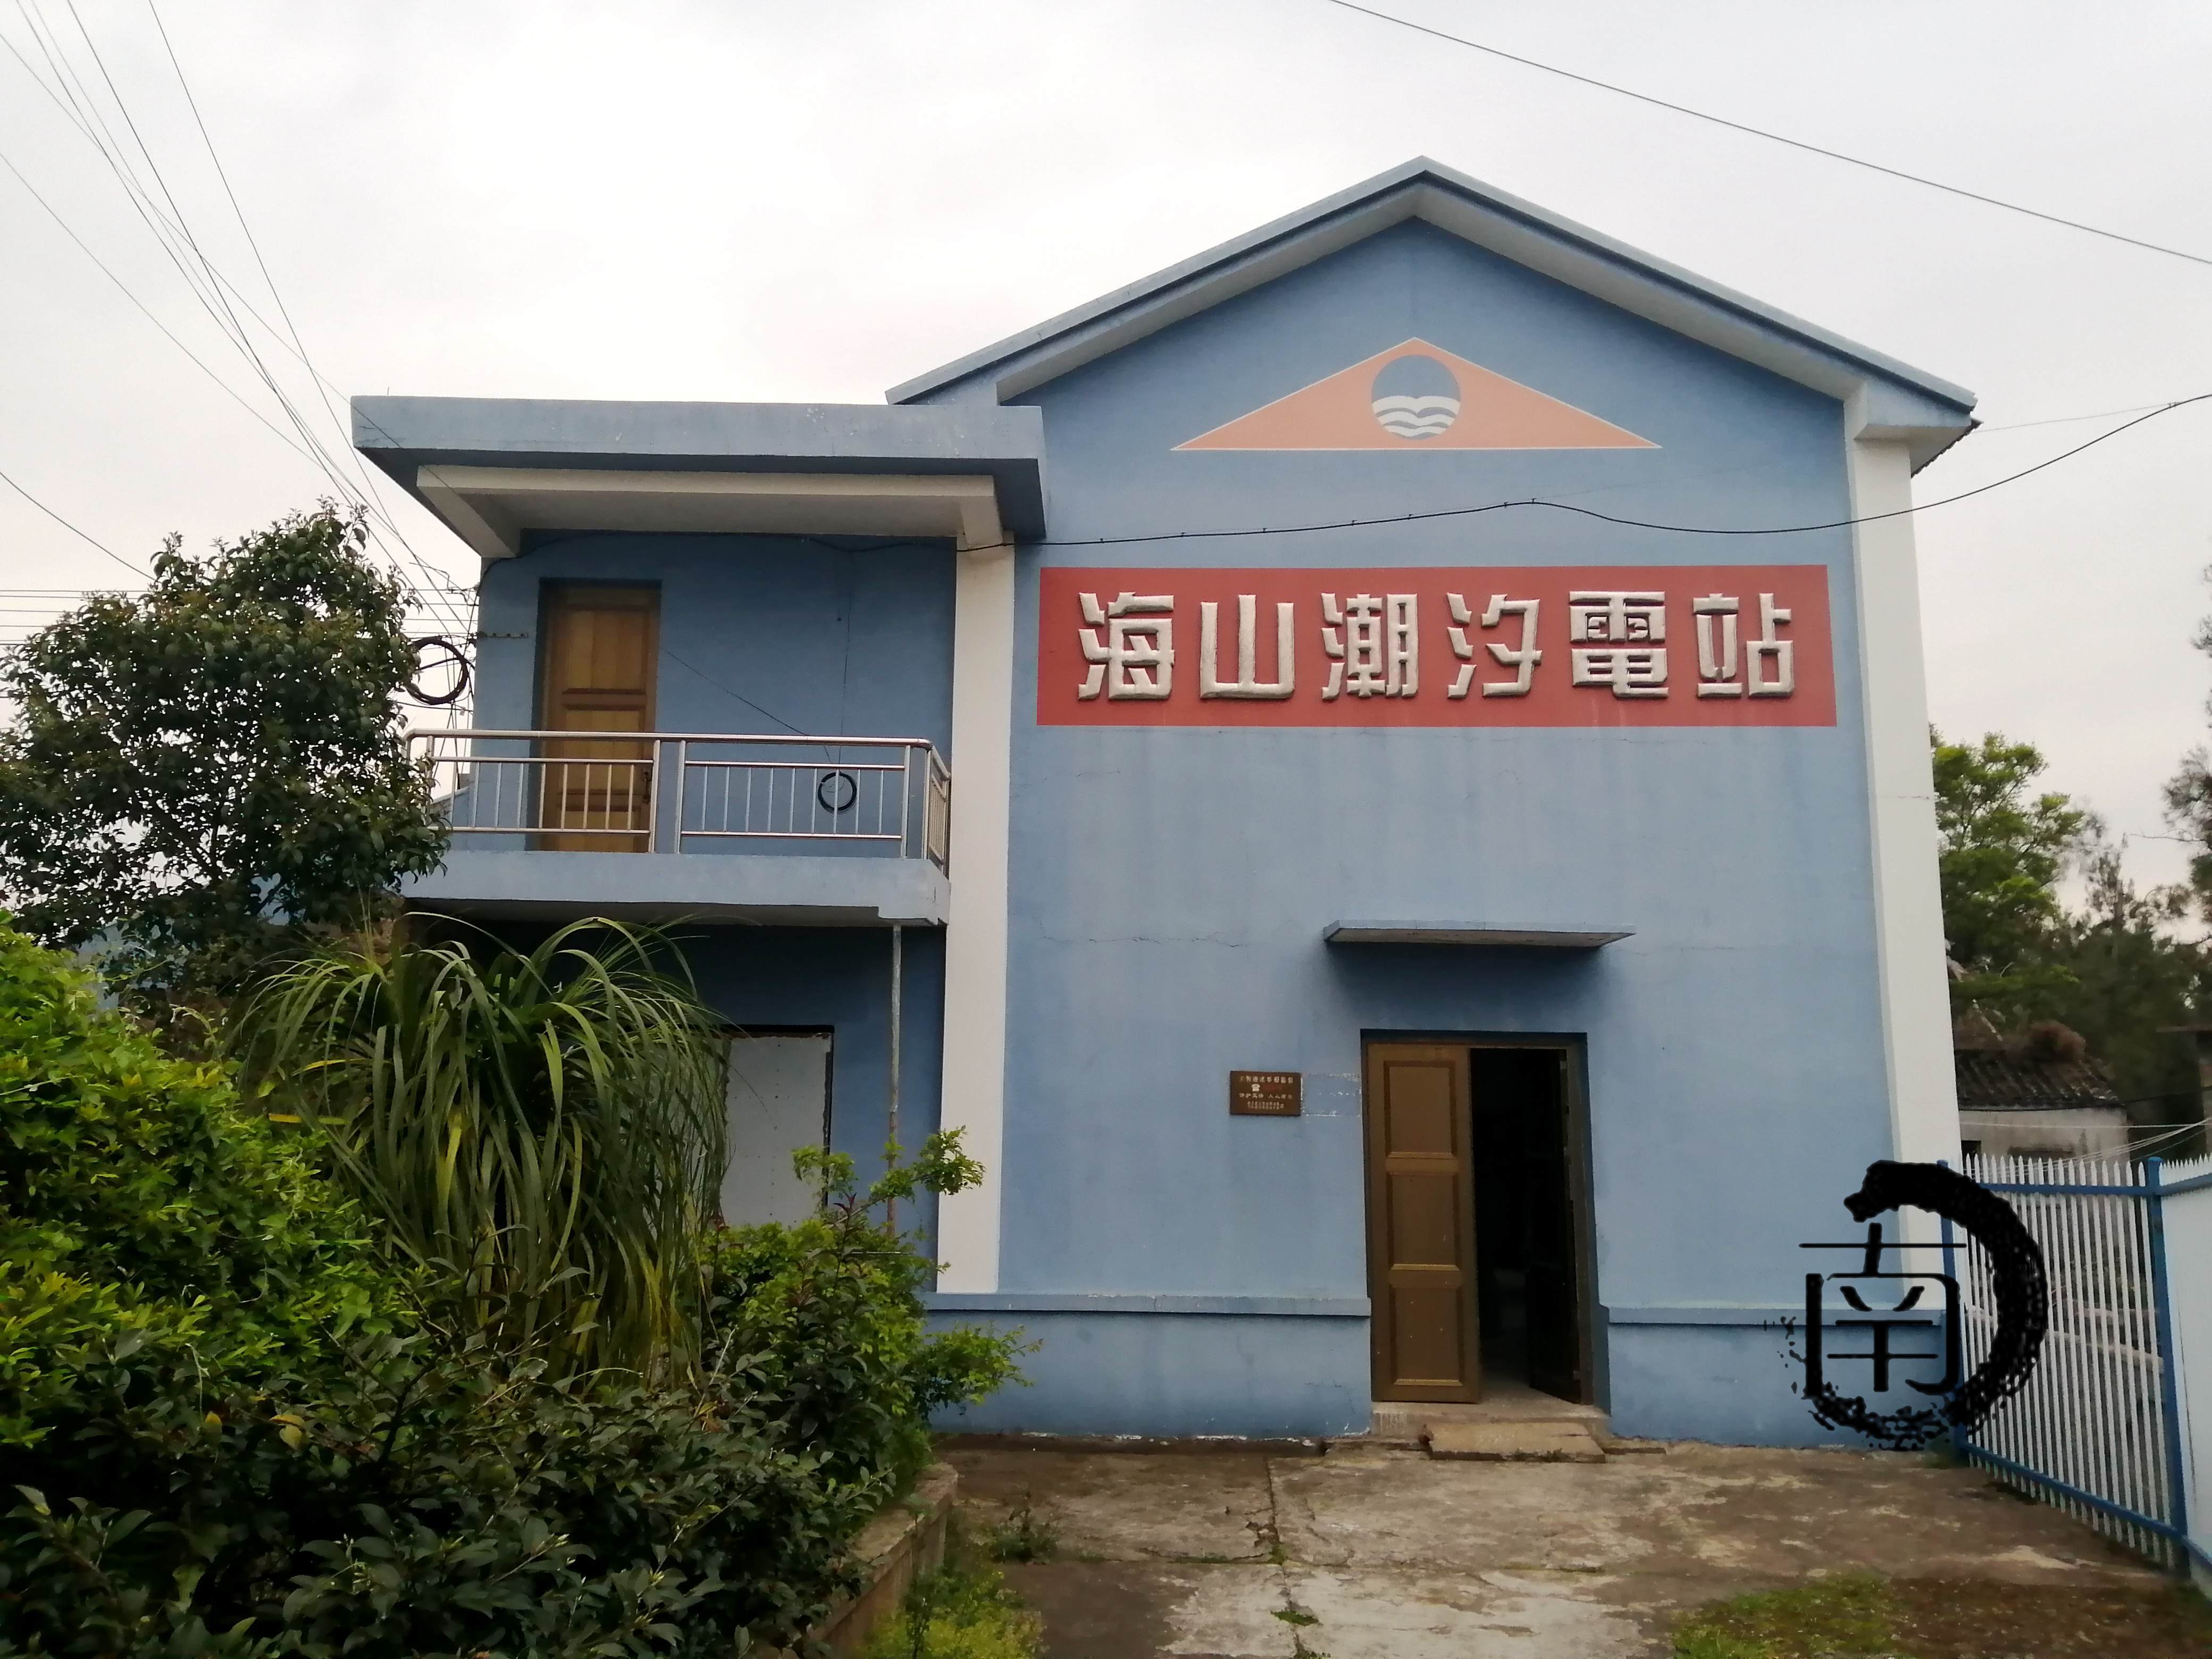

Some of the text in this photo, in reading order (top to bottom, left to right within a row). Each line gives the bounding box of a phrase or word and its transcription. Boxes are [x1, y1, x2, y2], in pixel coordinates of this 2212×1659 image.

[1078, 590, 1795, 701] 海山潮汐電站
